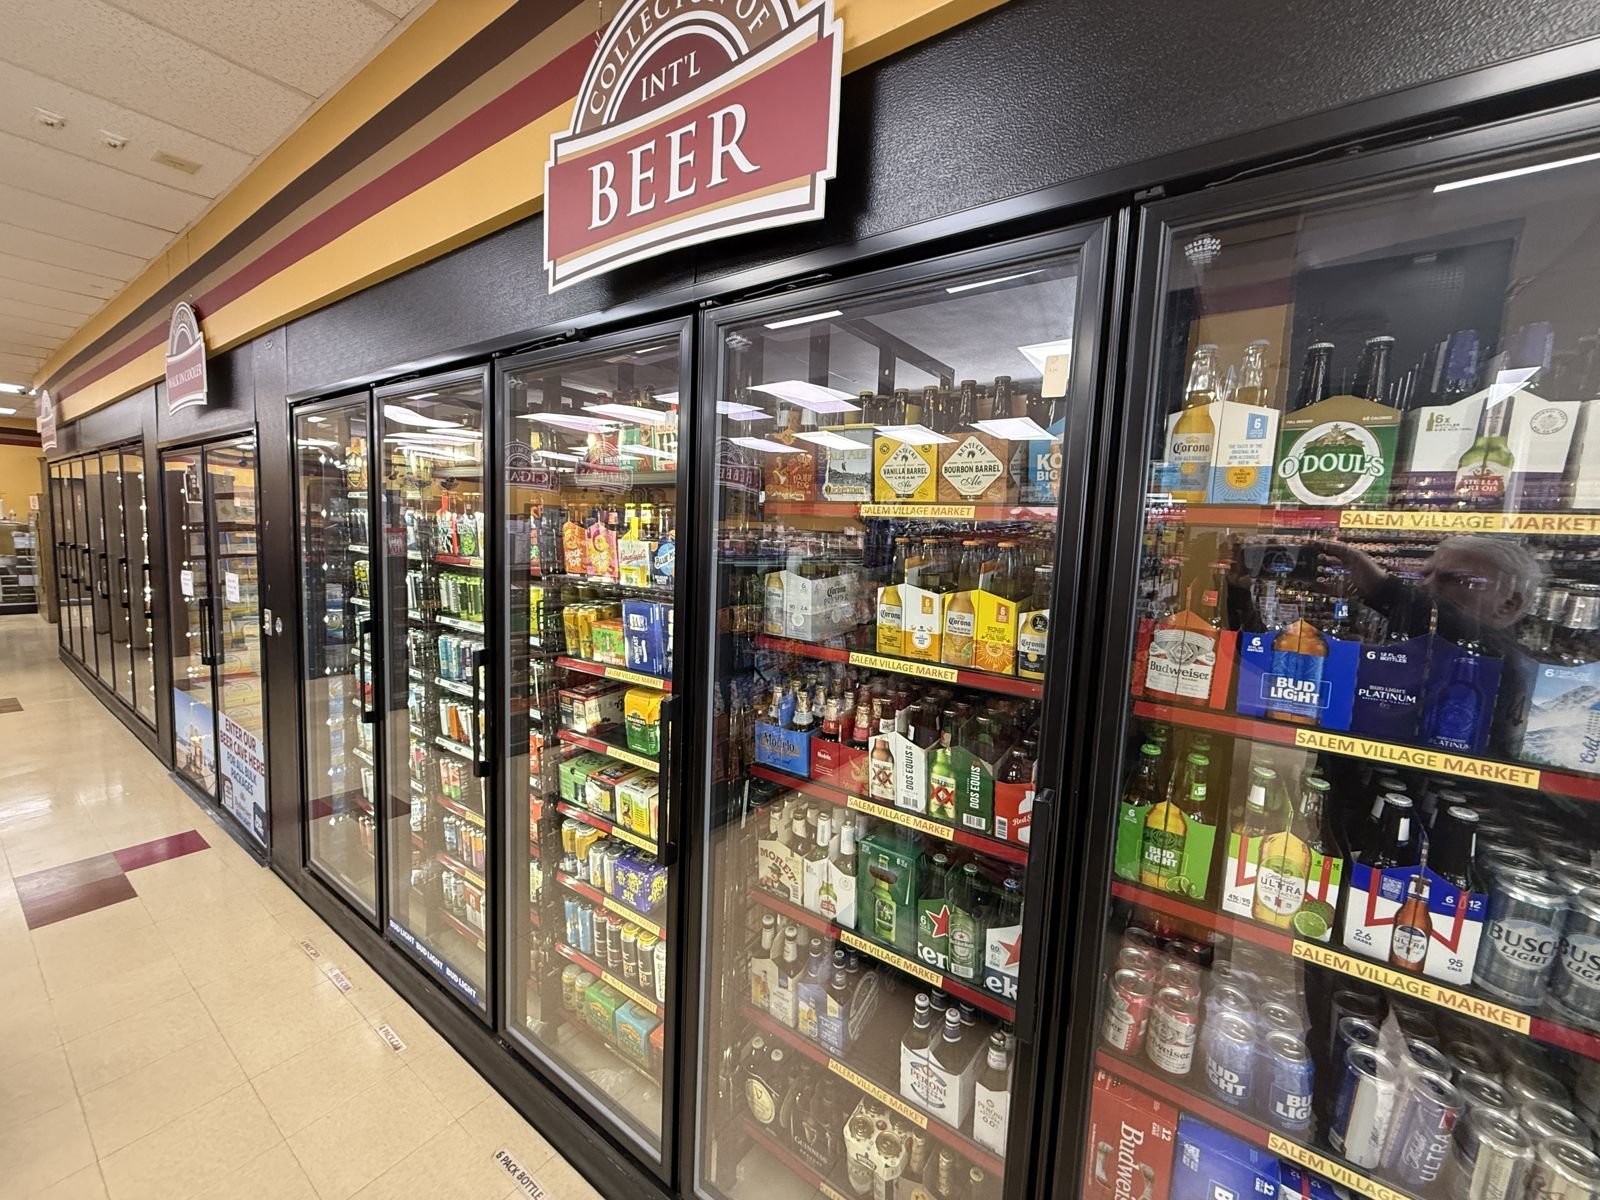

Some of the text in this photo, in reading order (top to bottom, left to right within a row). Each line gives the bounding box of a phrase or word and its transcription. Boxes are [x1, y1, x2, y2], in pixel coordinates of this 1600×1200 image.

[736, 0, 770, 34] OF
[640, 51, 701, 102] INT'L
[587, 103, 761, 231] BEER
[1254, 418, 1262, 429] 6
[957, 443, 987, 457] KENTUCKY
[1173, 442, 1210, 455] Corona
[944, 465, 973, 474] BOURBON
[975, 465, 1000, 473] BARREL
[1278, 453, 1385, 478] O'DOUL'S
[960, 475, 982, 486] Ale
[862, 506, 972, 516] SALEM VILLAGE MARKET
[1342, 511, 1598, 531] SALEM VILLAGE MARKET
[925, 599, 930, 607] 6
[880, 610, 901, 619] Corona
[949, 616, 971, 627] Corona
[1251, 637, 1261, 646] 6
[1366, 651, 1376, 660] 6
[851, 654, 955, 680] SALEM VILLAGE MARKET
[1150, 661, 1209, 681] Budweiser
[1545, 668, 1555, 677] 6
[1276, 677, 1315, 693] BUD
[1270, 687, 1320, 705] LIGHT
[1358, 688, 1416, 704] PLATINUM
[1297, 731, 1535, 786] SALEM VILLAGE MARKET
[905, 751, 914, 790] DOS EQUIS
[969, 766, 981, 809] DOS EQUIS
[848, 797, 952, 837] SALEM VILLAGE MARKET
[1128, 808, 1135, 817] 6
[1144, 852, 1178, 868] LIGHT
[1149, 845, 1175, 859] BUD
[1260, 877, 1303, 896] ULTRA
[1469, 900, 1482, 909] 12
[920, 915, 927, 925] 6
[389, 919, 415, 944] BUD LIGHT
[1355, 929, 1372, 941] 2.6
[415, 941, 443, 970] BUD LIGHT
[841, 933, 941, 984] SALEM VILLAGE MARKET
[1448, 958, 1463, 968] 95
[1501, 945, 1549, 964] LIGHT
[446, 967, 476, 998] BUD LIGHT
[1294, 945, 1527, 1028] SALEM VILLAGE MARKET
[829, 1061, 855, 1081] SALEM
[855, 1077, 887, 1100] VILLAGE
[887, 1095, 926, 1124] MARKET
[1162, 1127, 1171, 1141] 12
[1114, 1121, 1145, 1200] Budwei
[1419, 1133, 1452, 1182] ULTRA
[496, 1151, 544, 1200] 6 PACK BOTTLE
[1269, 1136, 1399, 1200] SALEM VILLAG
[1263, 1182, 1274, 1196] 12
